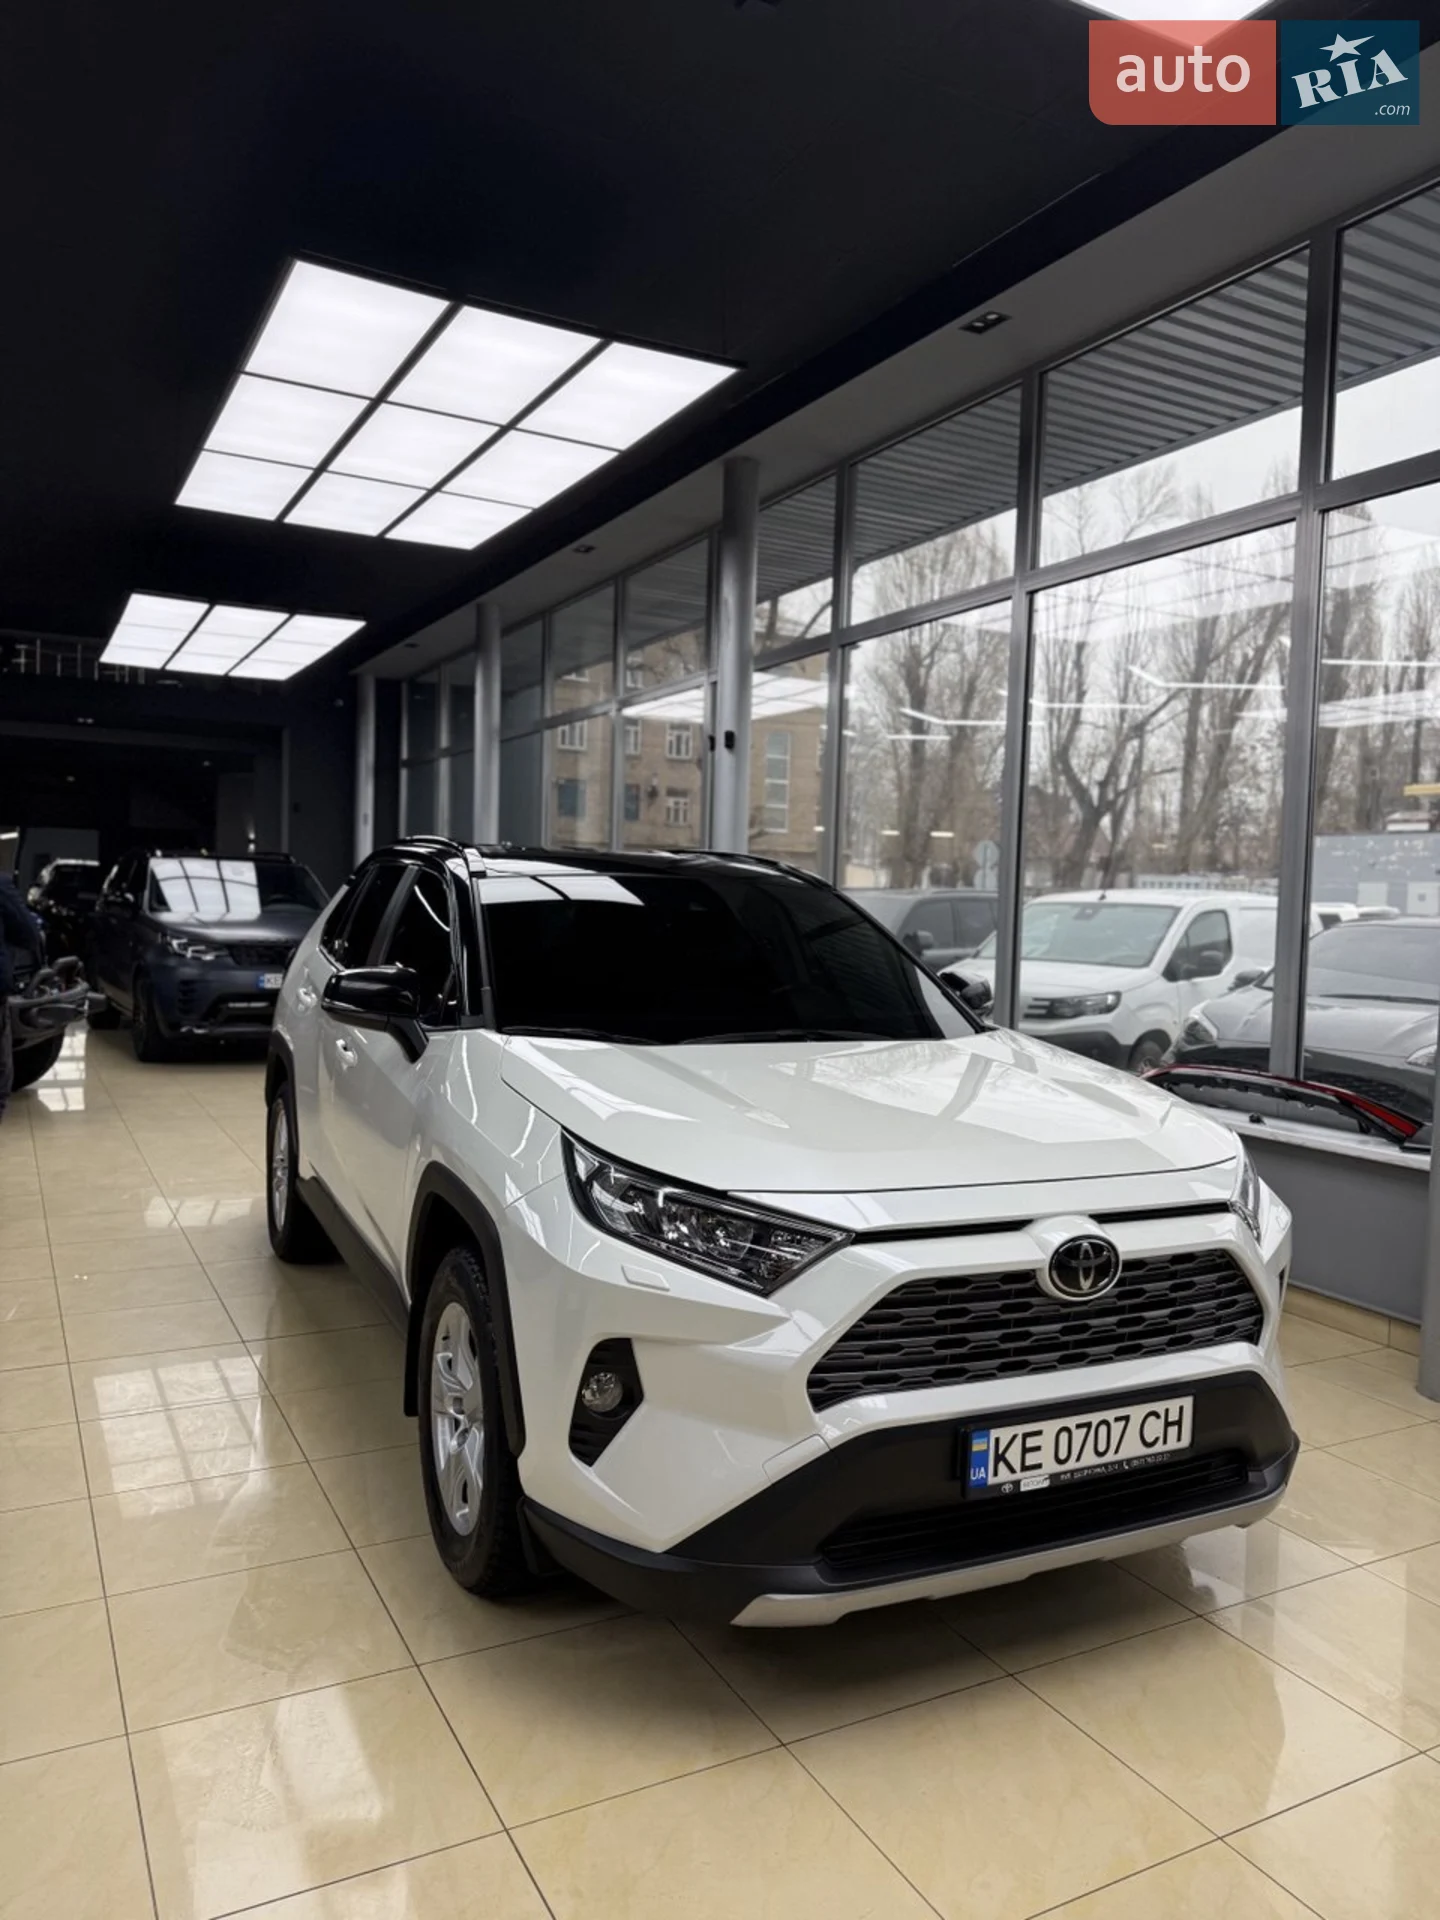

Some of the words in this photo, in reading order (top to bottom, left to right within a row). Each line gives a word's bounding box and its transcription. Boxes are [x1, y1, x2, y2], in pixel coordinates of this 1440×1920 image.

[992, 1429, 1043, 1478] KE
[1053, 1414, 1131, 1465] 0707
[1139, 1405, 1184, 1449] CH
[970, 1467, 986, 1481] UA
